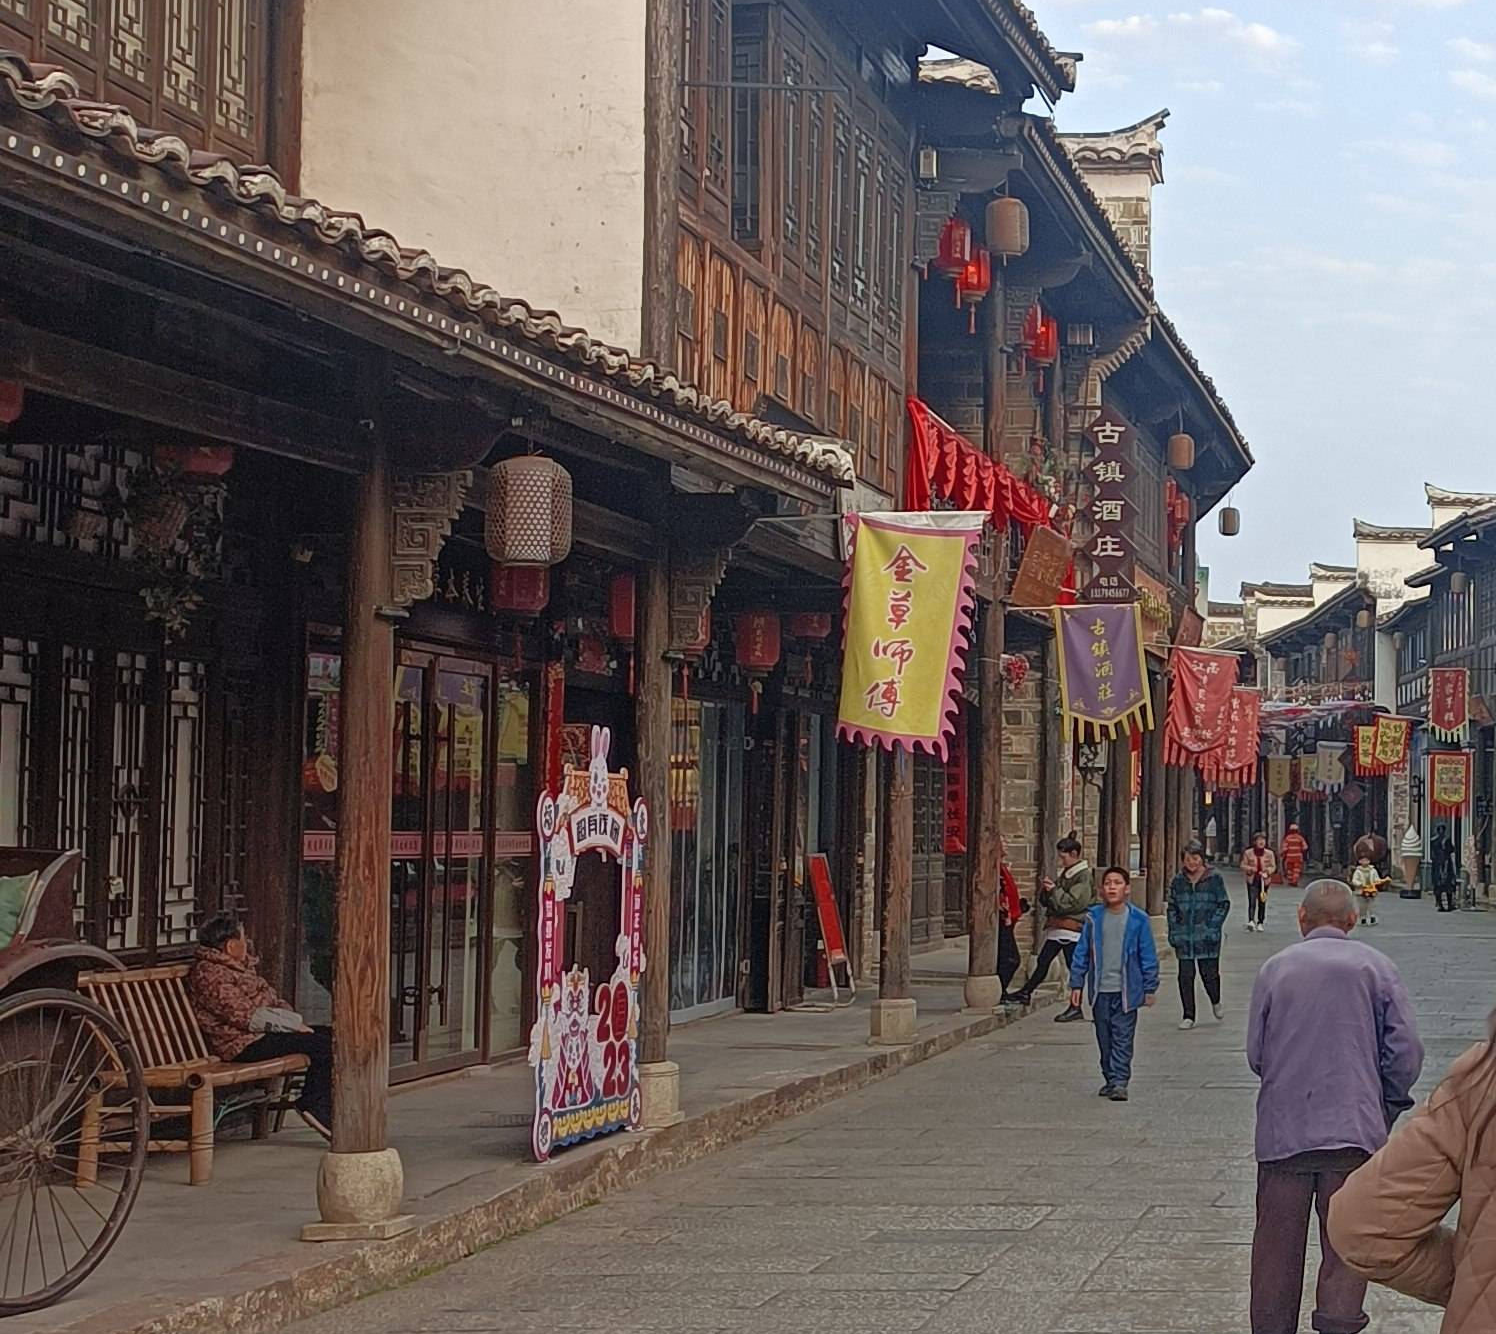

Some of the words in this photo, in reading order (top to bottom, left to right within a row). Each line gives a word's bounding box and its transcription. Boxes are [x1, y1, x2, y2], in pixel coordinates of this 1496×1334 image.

[1092, 422, 1126, 557] 古镇酒庄
[602, 1041, 630, 1098] 23
